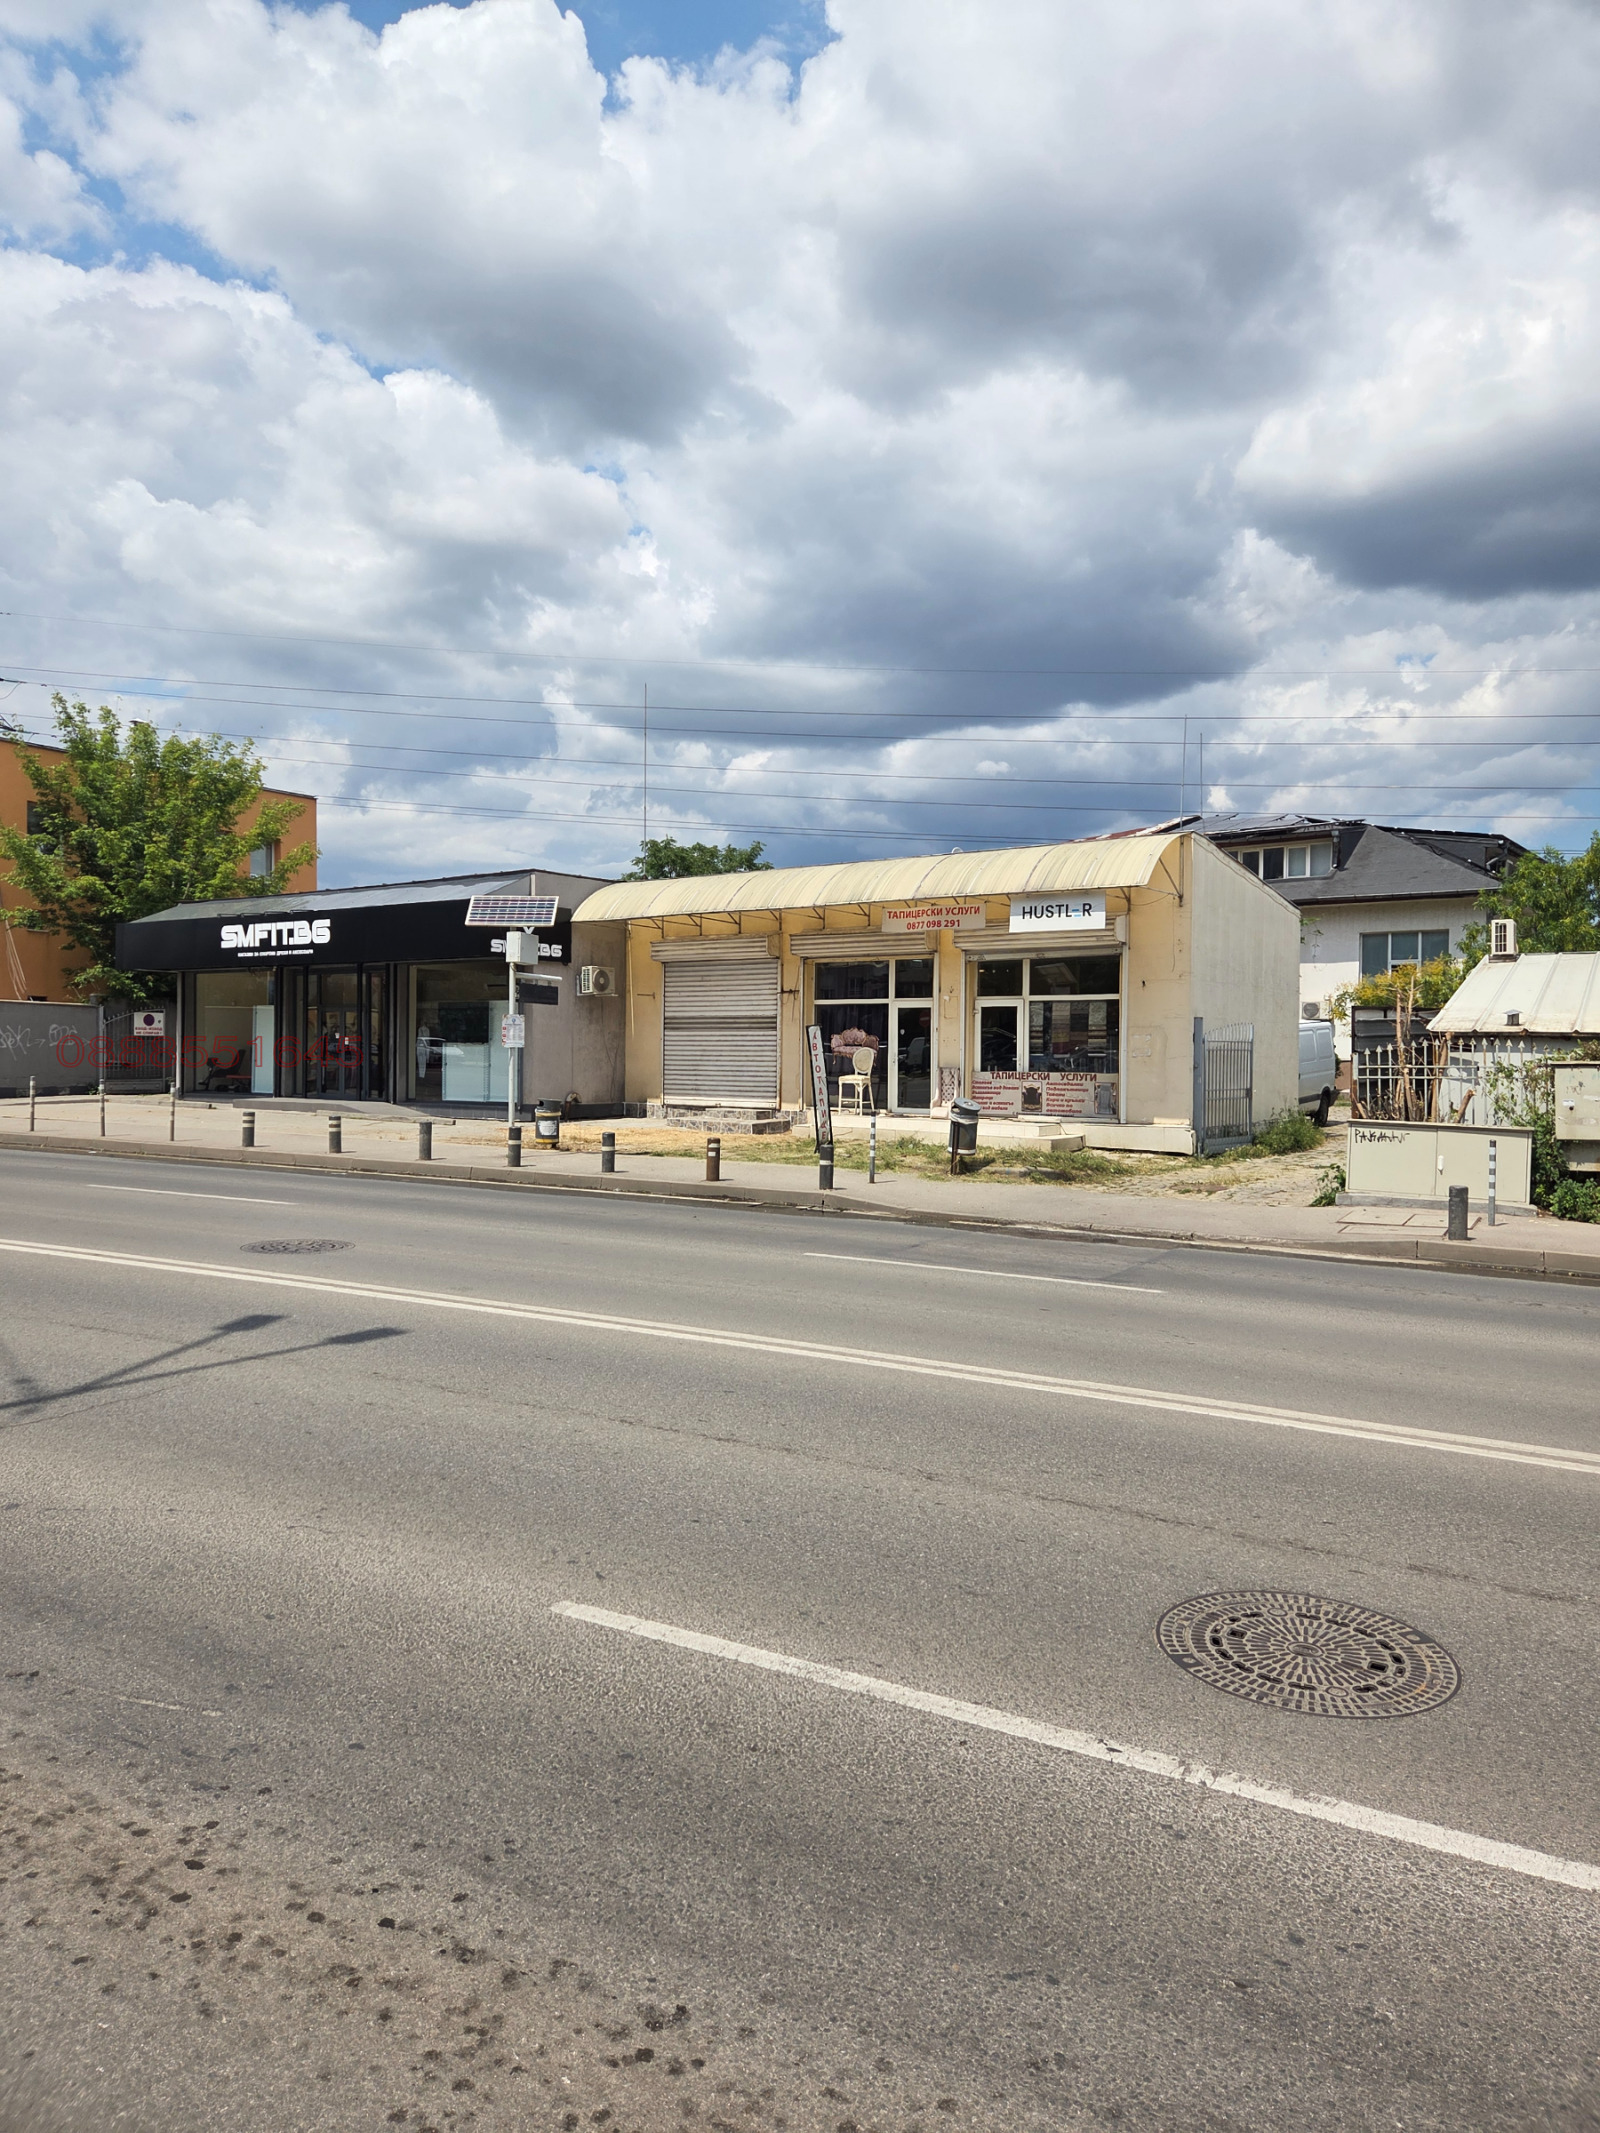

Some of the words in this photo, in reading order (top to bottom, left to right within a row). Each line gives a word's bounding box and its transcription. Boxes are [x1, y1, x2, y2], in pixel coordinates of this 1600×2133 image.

[887, 907, 943, 920] ТАПИЦЕРСКИ
[945, 905, 980, 916] УСЛУГИ
[906, 920, 925, 930] 0877
[926, 920, 942, 929] 098
[943, 919, 960, 928] 291
[221, 919, 331, 949] SMFIT.BG
[991, 1071, 1050, 1081] ТАПИЦЕРСКИ
[1060, 1073, 1097, 1082] УСЛУГИ
